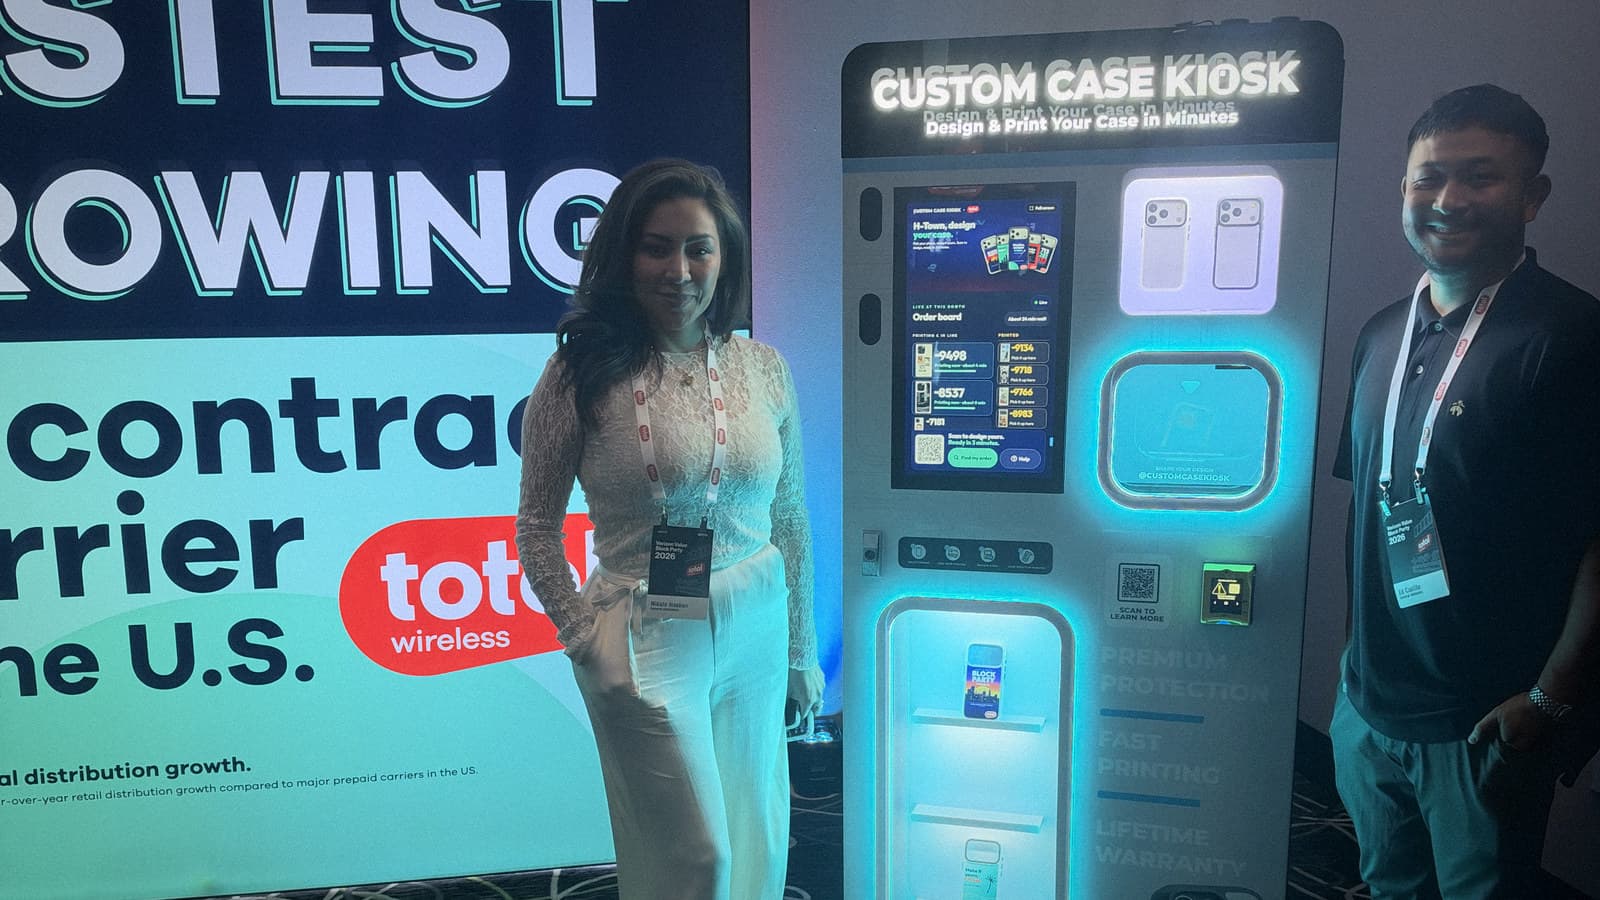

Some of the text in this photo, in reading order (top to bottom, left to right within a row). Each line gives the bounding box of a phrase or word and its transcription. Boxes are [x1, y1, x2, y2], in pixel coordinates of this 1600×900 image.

[0, 0, 620, 108] STEST
[872, 59, 1301, 109] CUSTOM CASE KIOSK
[926, 110, 1240, 137] Design & Print Your Case in Minutes
[912, 220, 976, 231] H-Town, design
[912, 232, 932, 241] your
[912, 311, 962, 321] Order board
[6, 377, 523, 482] contra
[1138, 471, 1231, 482] @CUSTOMCASEKIOSK
[0, 489, 304, 600] rrier
[1388, 533, 1406, 545] 2026
[654, 551, 676, 560] 2026
[1110, 613, 1164, 622] LEARN MORE
[1119, 606, 1156, 615] SCAN TO
[391, 627, 511, 653] wireless
[128, 618, 315, 690] U.S.
[1101, 647, 1228, 671] PREMIUM
[1101, 675, 1269, 701] PROTECTION
[1100, 730, 1162, 750] FAST
[0, 757, 251, 786] al distribution growth.
[72, 790, 102, 802] retail
[105, 786, 173, 800] distribution
[176, 783, 216, 796] growth
[219, 780, 279, 793] compared
[281, 780, 293, 788] to
[296, 777, 330, 789] major
[333, 773, 377, 787] prepaid
[380, 770, 424, 782] carriers
[427, 769, 437, 778] in
[439, 767, 458, 777] the
[460, 766, 479, 776] US.
[1099, 758, 1221, 785] PRINTING
[1097, 819, 1209, 846] LIFETIME
[1096, 846, 1248, 877] WARRANTY
